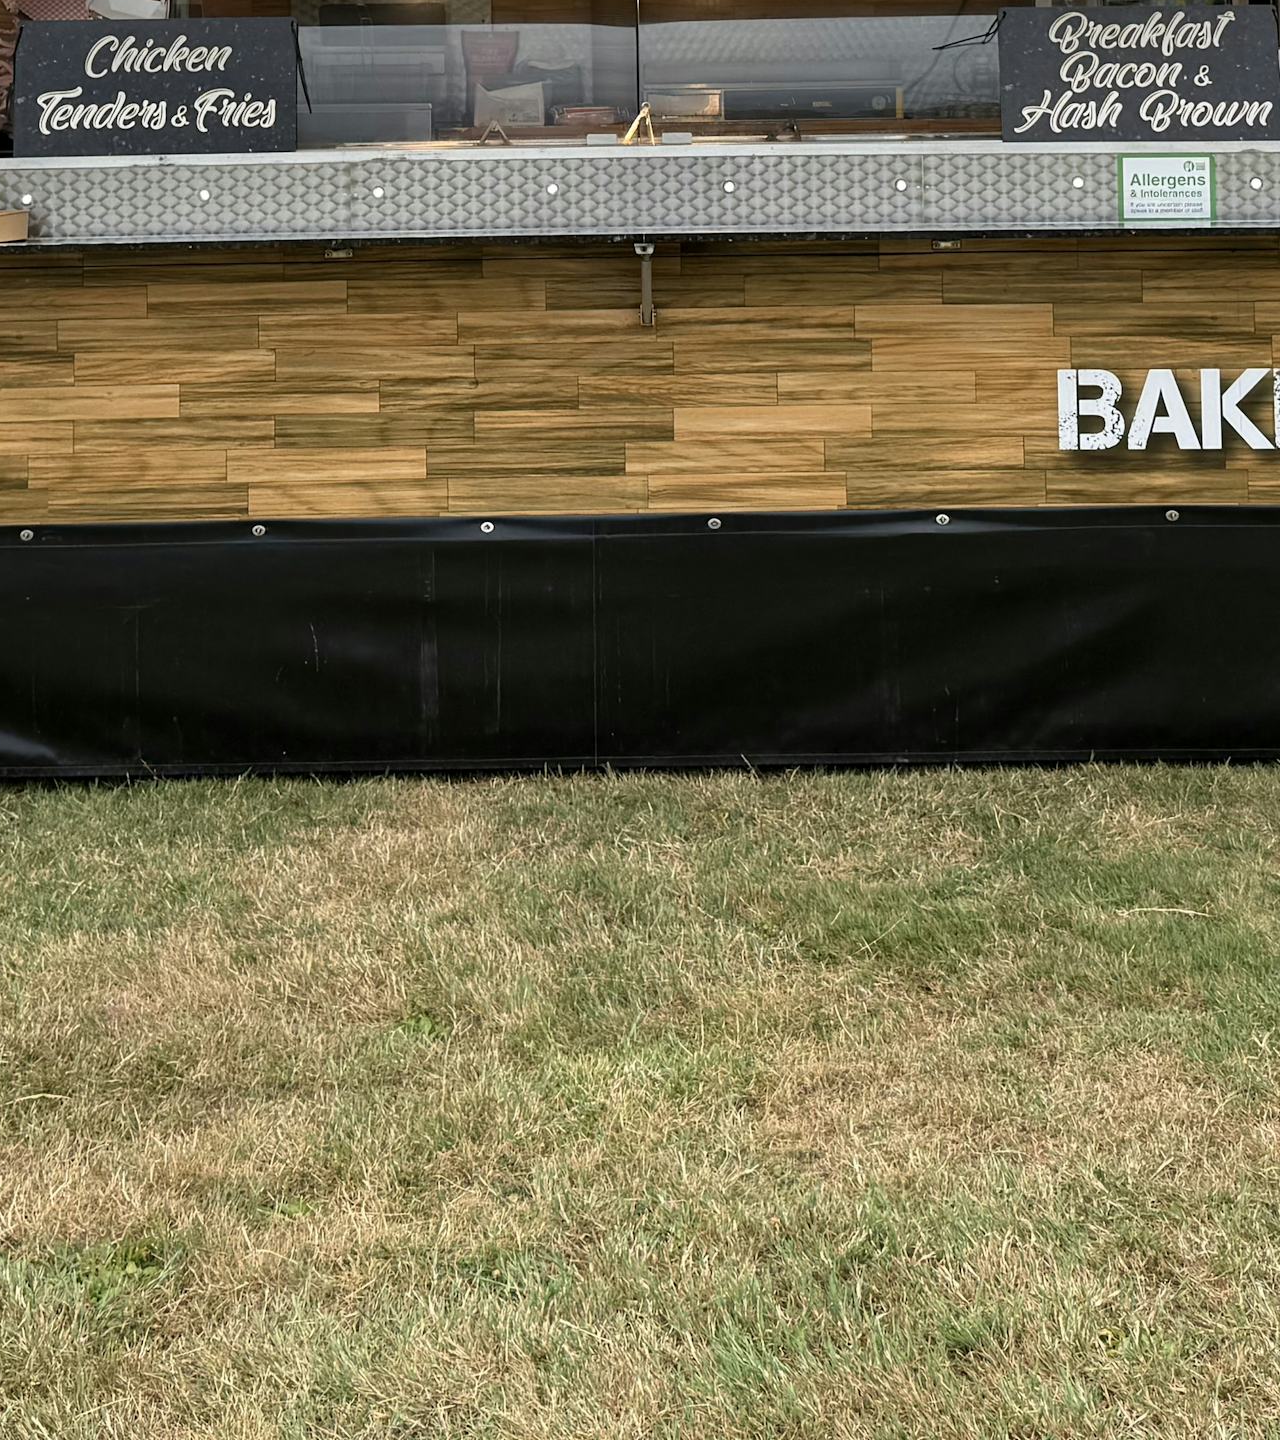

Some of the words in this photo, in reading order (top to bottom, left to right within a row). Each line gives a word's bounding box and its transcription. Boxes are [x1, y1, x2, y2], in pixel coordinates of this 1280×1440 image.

[1049, 11, 1236, 56] Breakfast
[85, 34, 232, 79] Chicken
[1060, 51, 1183, 93] Bacon
[1194, 65, 1212, 86] &
[37, 86, 166, 135] Tenders
[171, 106, 189, 127] &
[194, 88, 276, 132] Fries
[1014, 90, 1123, 134] Hash
[1140, 89, 1273, 132] Brown
[1130, 173, 1205, 189] Allergens
[1141, 189, 1202, 197] Intolerances
